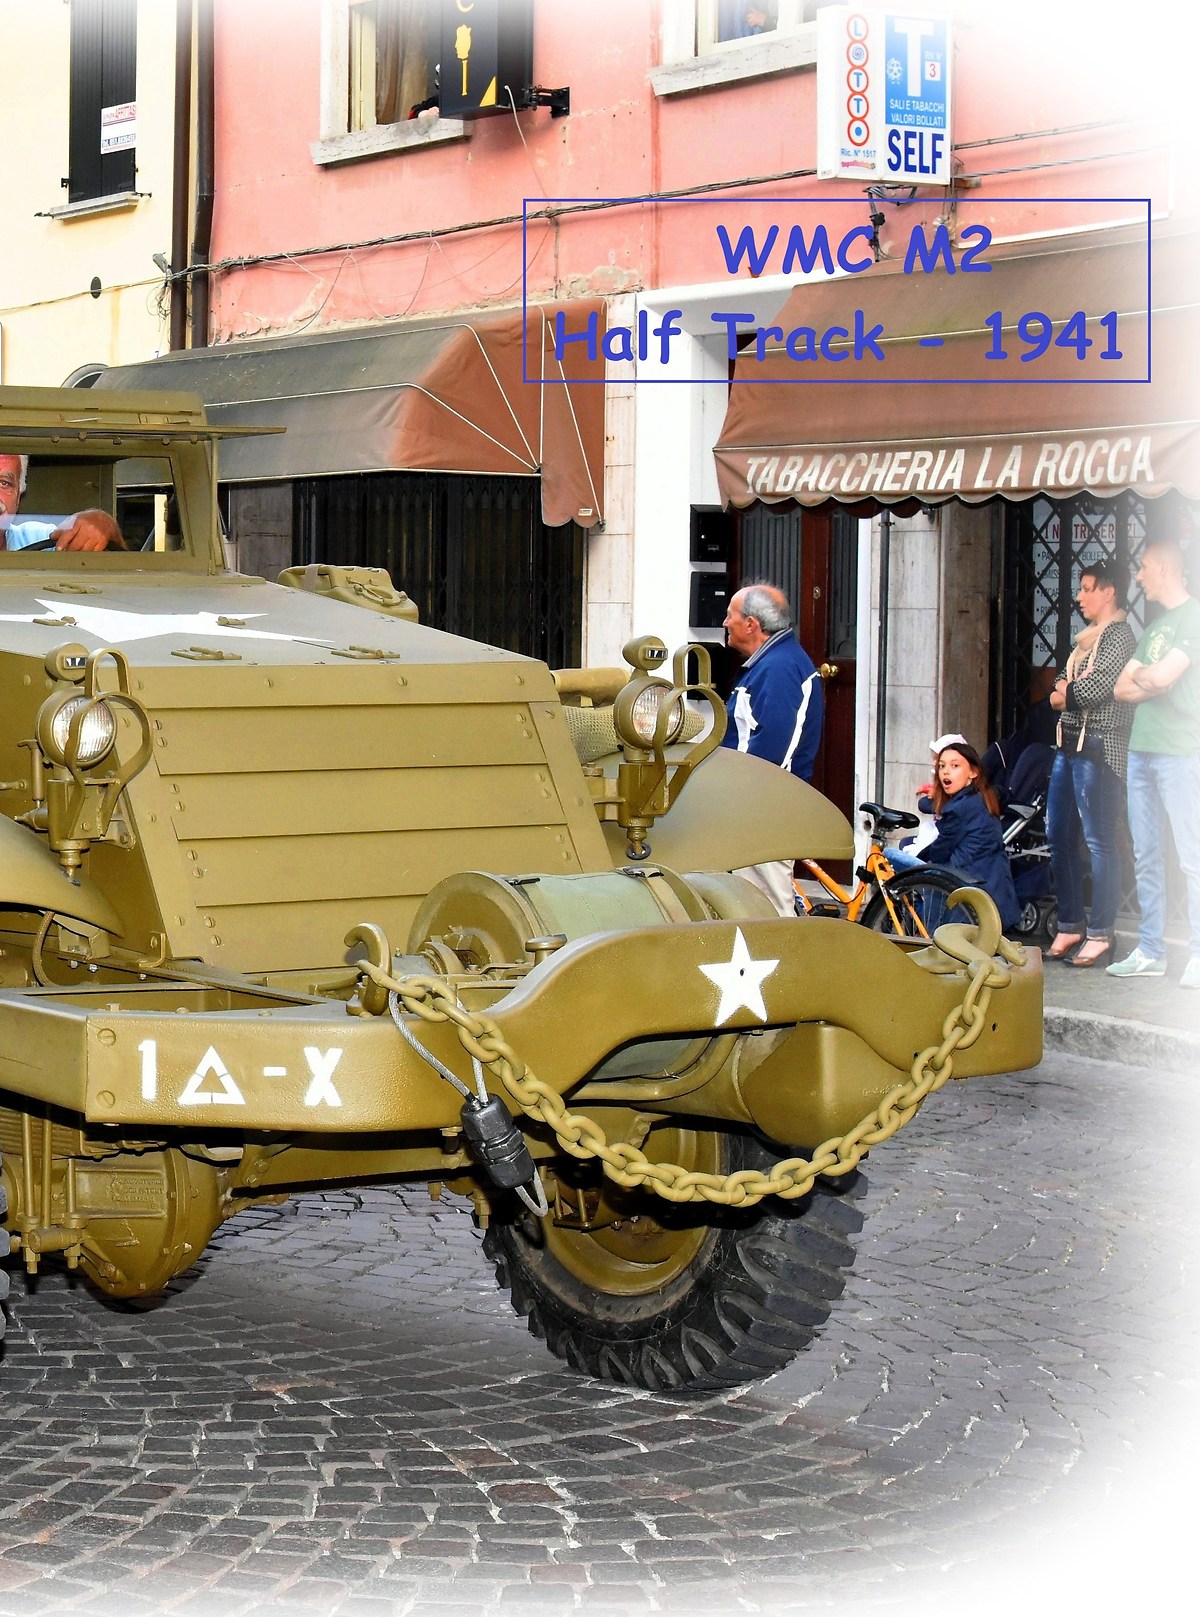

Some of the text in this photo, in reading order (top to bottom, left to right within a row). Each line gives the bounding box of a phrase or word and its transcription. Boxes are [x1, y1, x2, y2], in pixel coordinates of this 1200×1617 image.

[929, 63, 936, 78] 3
[890, 98, 945, 113] SALI E TABACCHI
[891, 113, 944, 126] VALORI BOLLATI
[887, 128, 945, 175] SELF
[746, 436, 1155, 494] TABACCHERIA LA ROCCA
